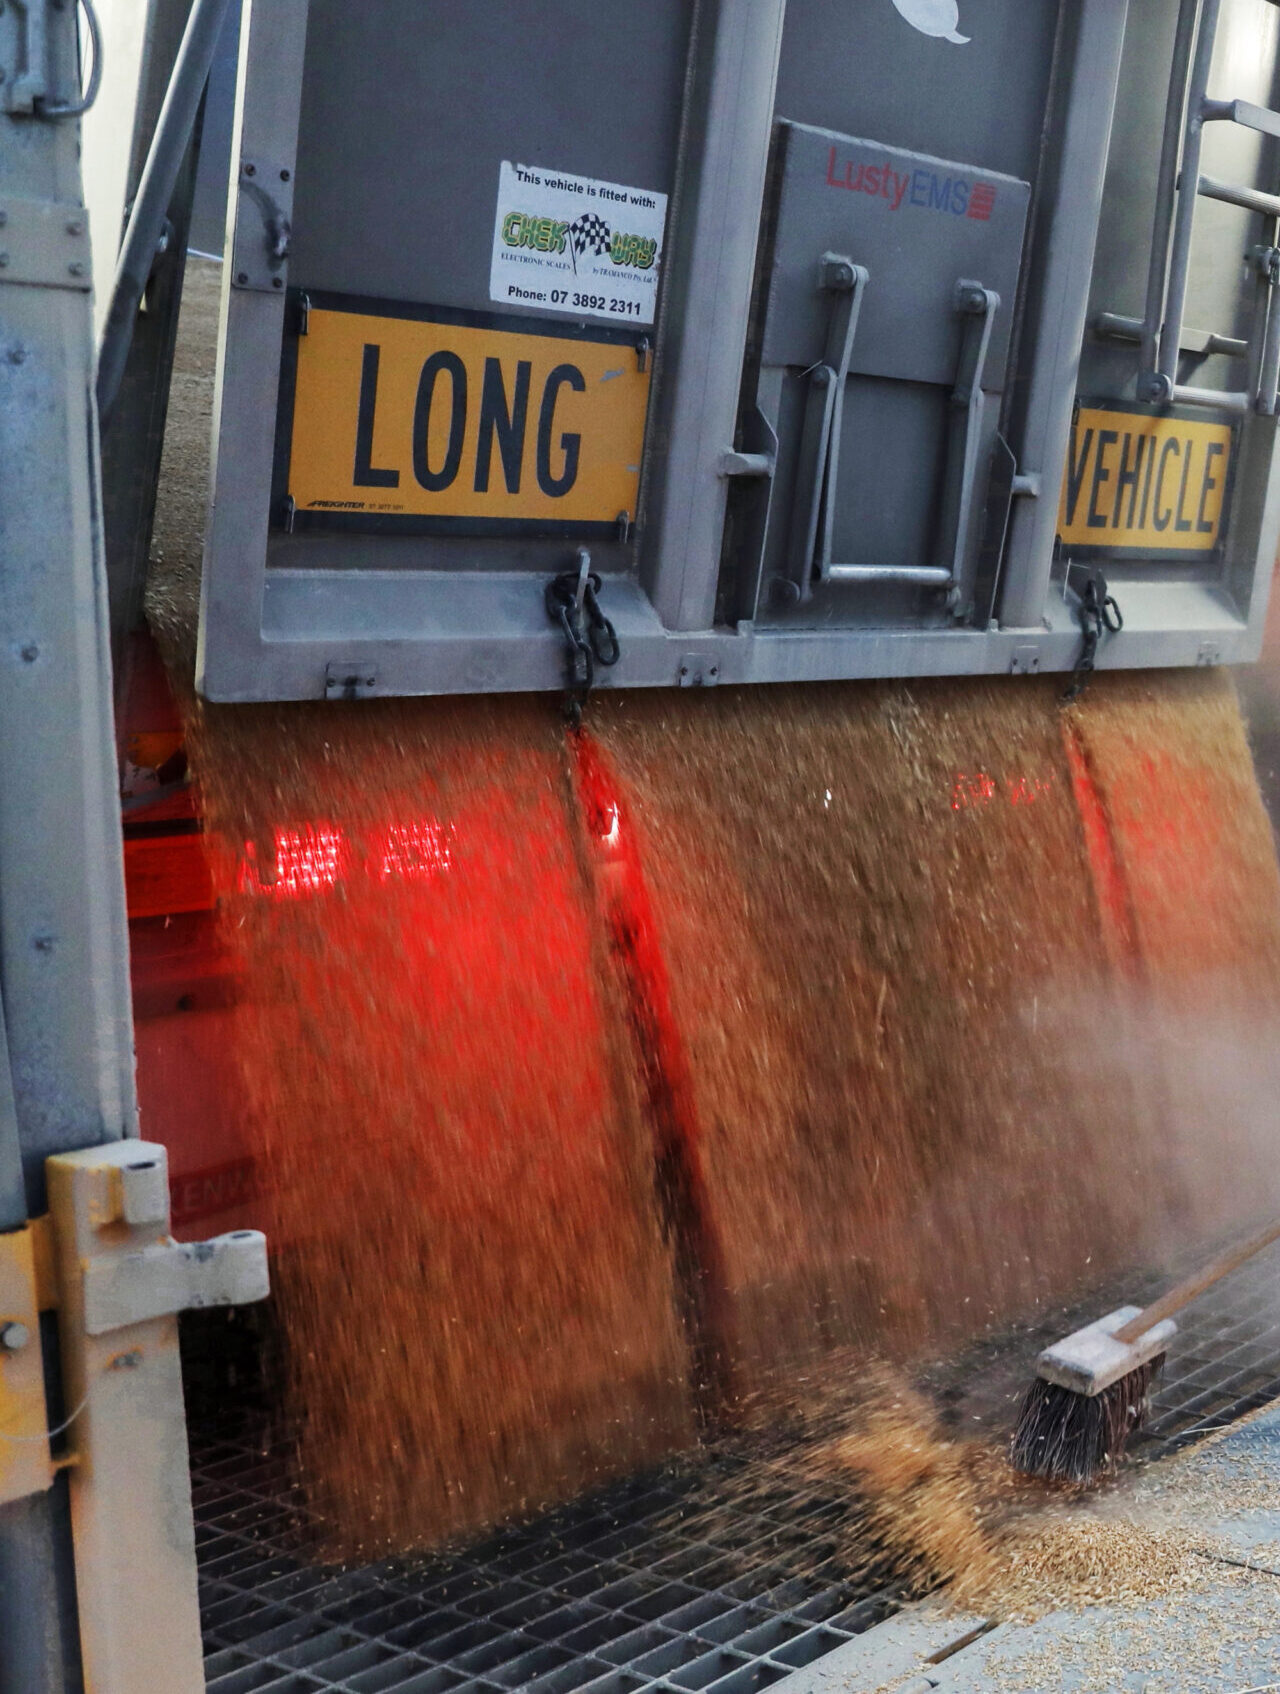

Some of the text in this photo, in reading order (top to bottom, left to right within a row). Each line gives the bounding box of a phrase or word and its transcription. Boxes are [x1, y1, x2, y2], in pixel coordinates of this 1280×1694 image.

[516, 170, 656, 209] This vehicle is fitted with:
[826, 146, 969, 216] LustyEMS
[501, 252, 571, 270] ELECTRONIC SCALES
[502, 212, 657, 269] CHEK WAY
[508, 285, 641, 316] Phone: 07 3892 2311
[353, 343, 587, 498] LONG
[1065, 427, 1225, 534] VEHICLE
